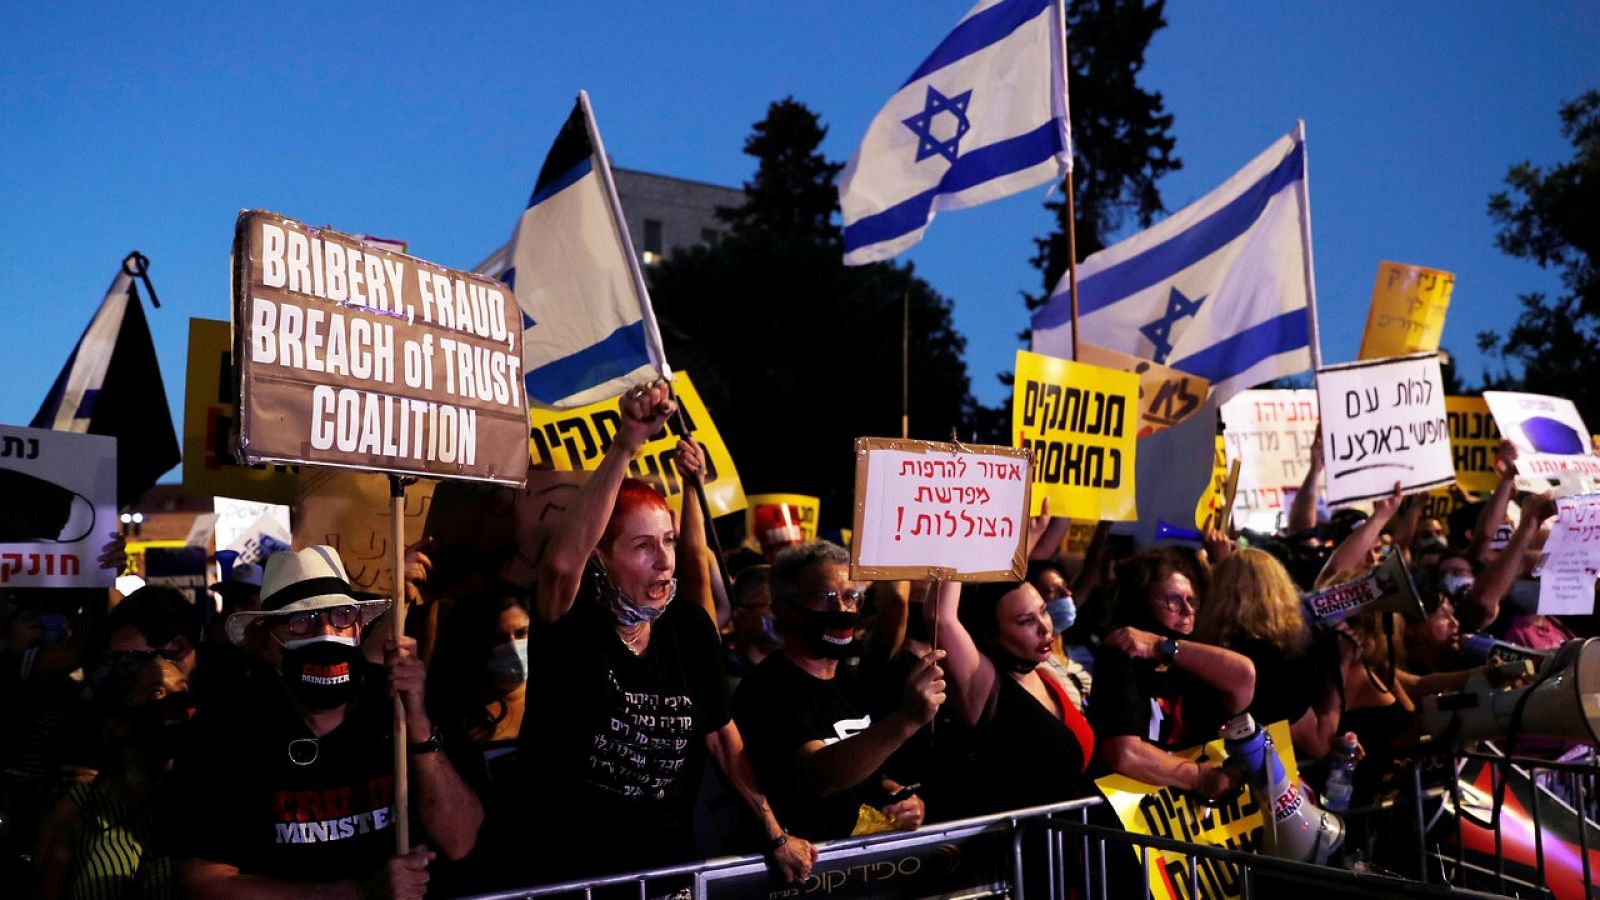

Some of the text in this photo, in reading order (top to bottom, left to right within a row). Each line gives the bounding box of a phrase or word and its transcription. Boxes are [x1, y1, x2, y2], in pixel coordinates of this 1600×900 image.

[262, 223, 516, 352] BRIBERY, FRAUD,
[252, 298, 521, 408] BREACH of TRUST
[1023, 380, 1126, 438] מנותקים
[1254, 401, 1319, 422] תניהו
[1346, 386, 1380, 419] עם
[310, 385, 477, 466] COALITION
[898, 456, 1022, 482] אסור להרפות
[914, 485, 991, 505] מפרשת
[894, 505, 1014, 542] הצוללות!
[1314, 582, 1372, 608] CRIME
[1316, 593, 1375, 615] MINISTER
[301, 673, 351, 685] MINISTER
